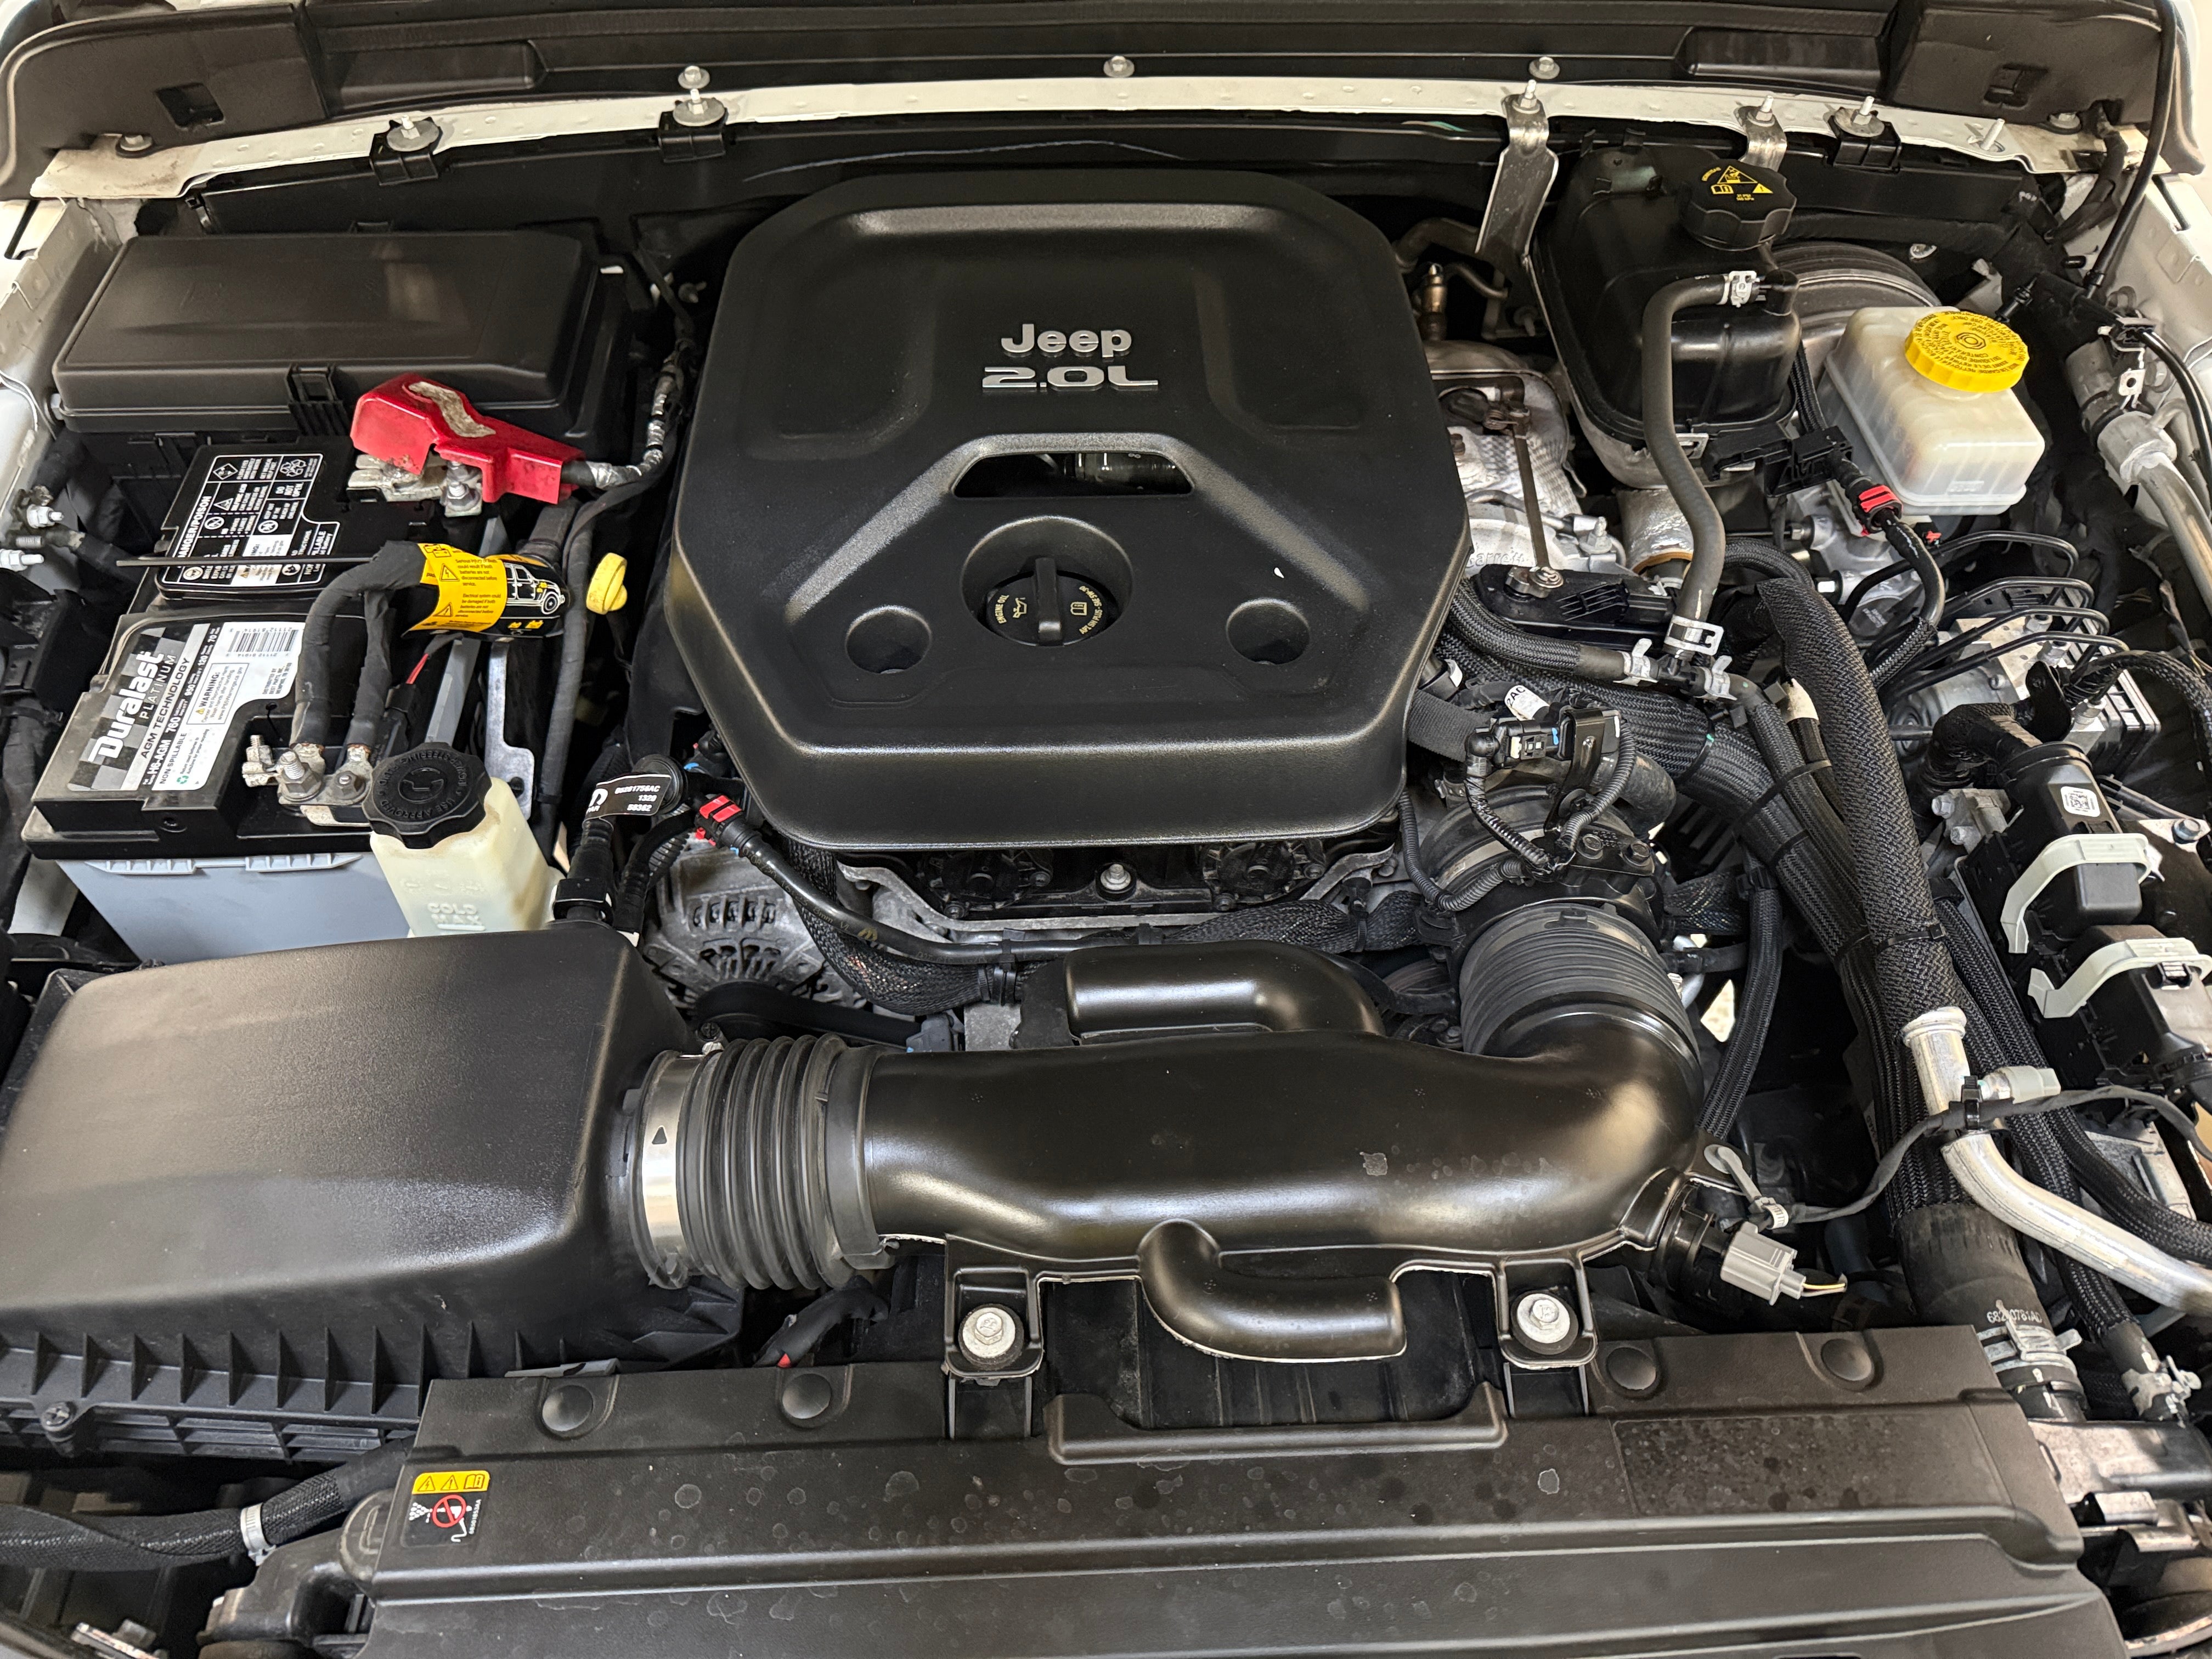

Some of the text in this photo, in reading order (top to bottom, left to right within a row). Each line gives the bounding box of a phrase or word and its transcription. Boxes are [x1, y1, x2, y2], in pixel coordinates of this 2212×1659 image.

[1001, 324, 1132, 357] Jeep
[982, 366, 1159, 388] 2.0L
[283, 485, 294, 495] NOT
[995, 595, 1009, 624] ENGINE OIL
[1092, 597, 1102, 607] SAE
[1094, 609, 1103, 622] PLUS
[1079, 626, 1092, 634] API
[138, 654, 177, 719] PLATINUM
[198, 672, 221, 707] WARNING:
[87, 650, 166, 761] Duralast
[139, 733, 158, 758] AGM
[152, 657, 191, 729] TECHNOLOGY
[146, 739, 172, 774] H6-AGM
[164, 716, 182, 732] 760
[183, 684, 196, 696] 950
[196, 655, 208, 665] 120
[159, 733, 187, 783] NON-SPILLABLE
[400, 751, 450, 764] STEERING
[381, 798, 455, 819] USE APPROVED
[427, 902, 477, 915] COLD
